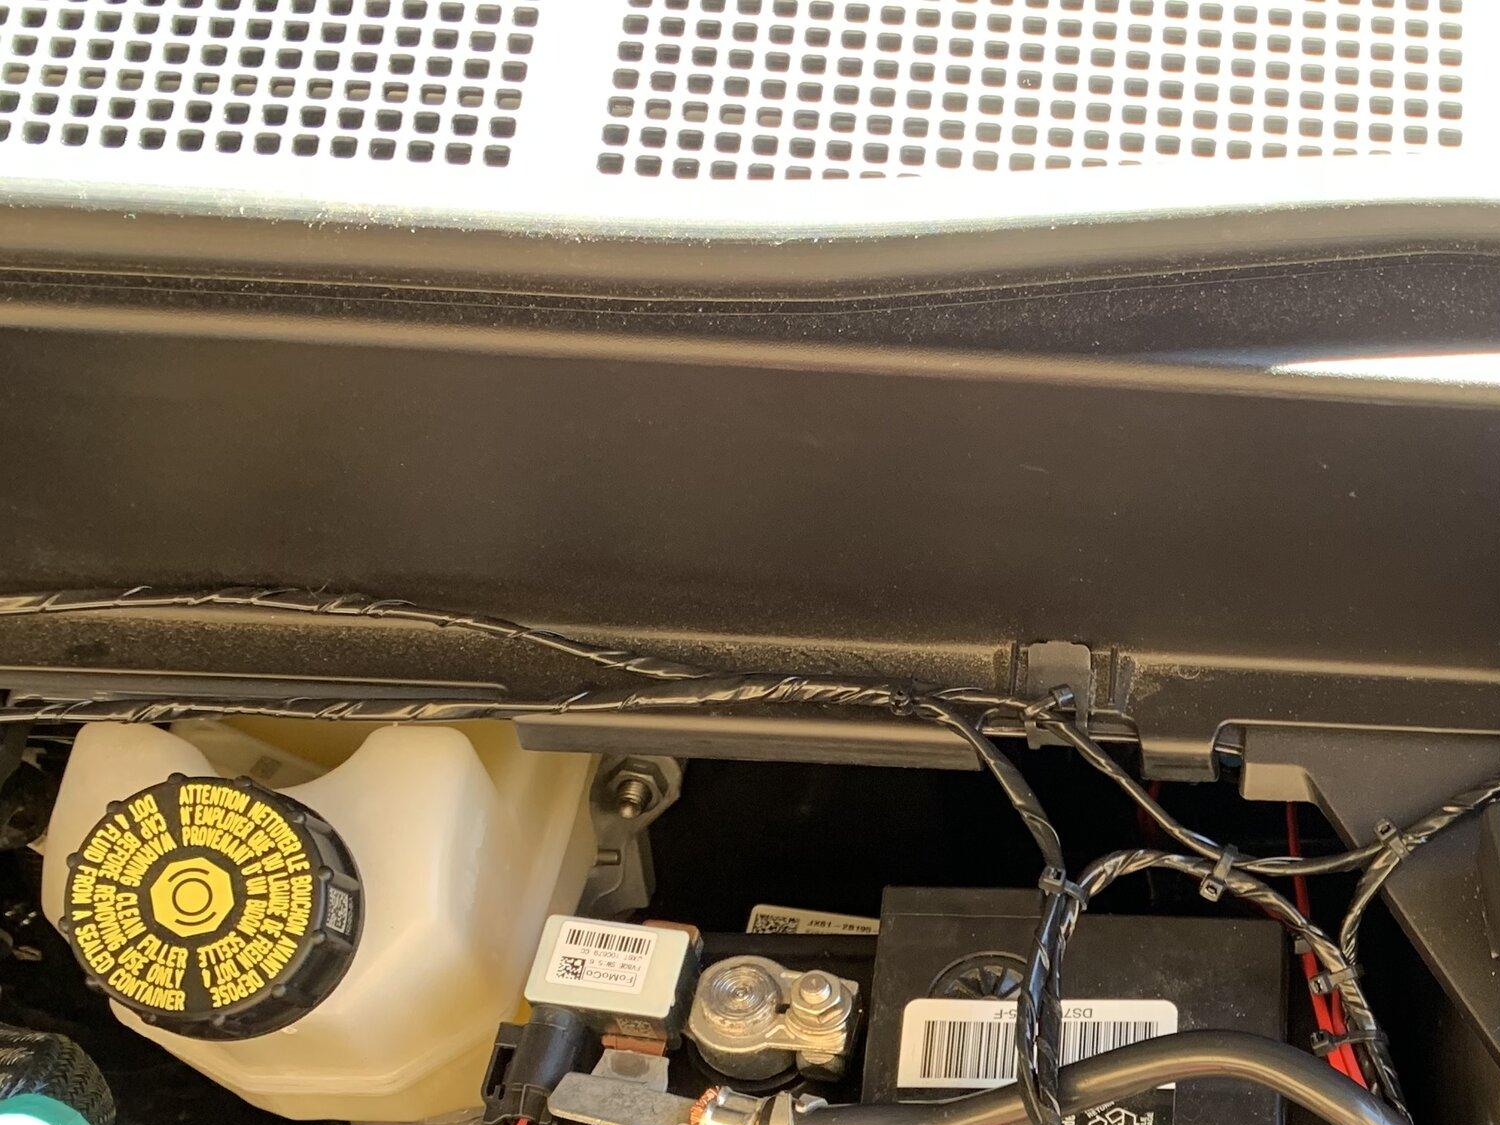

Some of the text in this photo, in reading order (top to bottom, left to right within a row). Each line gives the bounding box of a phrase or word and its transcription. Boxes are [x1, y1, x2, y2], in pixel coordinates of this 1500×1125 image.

[128, 794, 158, 822] DOT
[179, 784, 250, 813] ATTENTION
[83, 823, 121, 863] FLUID
[247, 801, 302, 856] NETTOYER
[248, 830, 275, 856] QUE
[182, 826, 254, 865] PROVENANT
[237, 899, 267, 937] BIDON
[262, 852, 285, 872] DU
[286, 853, 310, 873] LE
[72, 865, 98, 904] FROM
[93, 813, 184, 989] CAP BEFORE REMOVING USE ONLY
[116, 831, 188, 968] WARNING CLEAN FILLER
[267, 872, 290, 918] LIQUIDE
[72, 911, 93, 921] A
[285, 875, 312, 936] BOUCHON
[260, 919, 284, 938] DE
[75, 924, 115, 974] SEALED
[236, 935, 273, 970] FREIN
[260, 935, 298, 979] AVANT
[108, 968, 185, 1011] CONTAINER
[215, 959, 240, 985] DOT
[586, 970, 633, 983] FoMoCo
